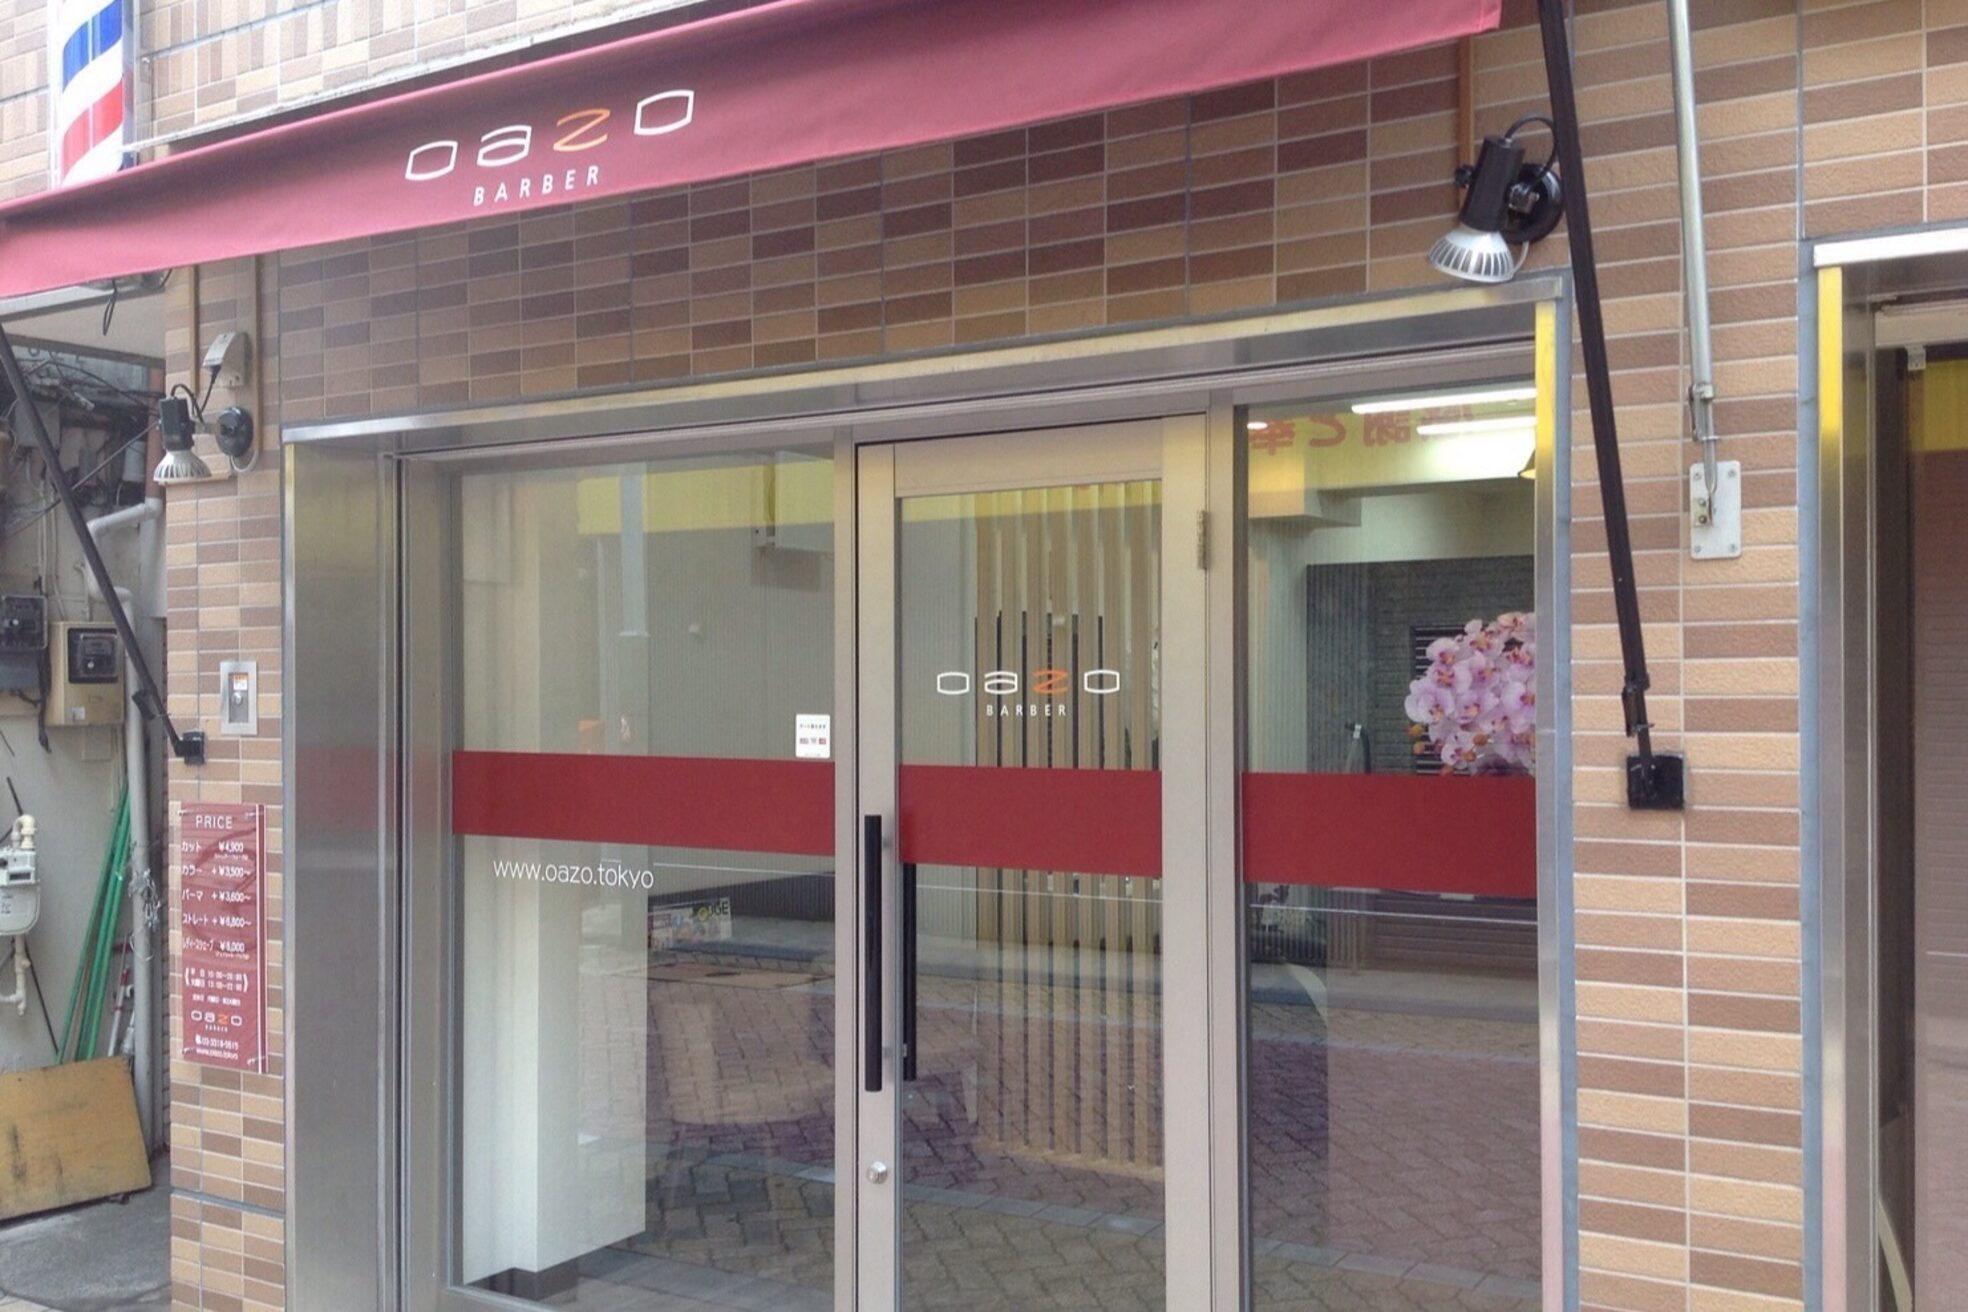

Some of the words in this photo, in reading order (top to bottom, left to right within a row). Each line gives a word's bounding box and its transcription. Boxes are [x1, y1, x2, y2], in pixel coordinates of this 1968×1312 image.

[472, 165, 600, 207] BARBER
[986, 703, 1067, 717] BARBER
[195, 815, 233, 830] PRICE
[493, 860, 654, 889] www.oazo.tokyo
